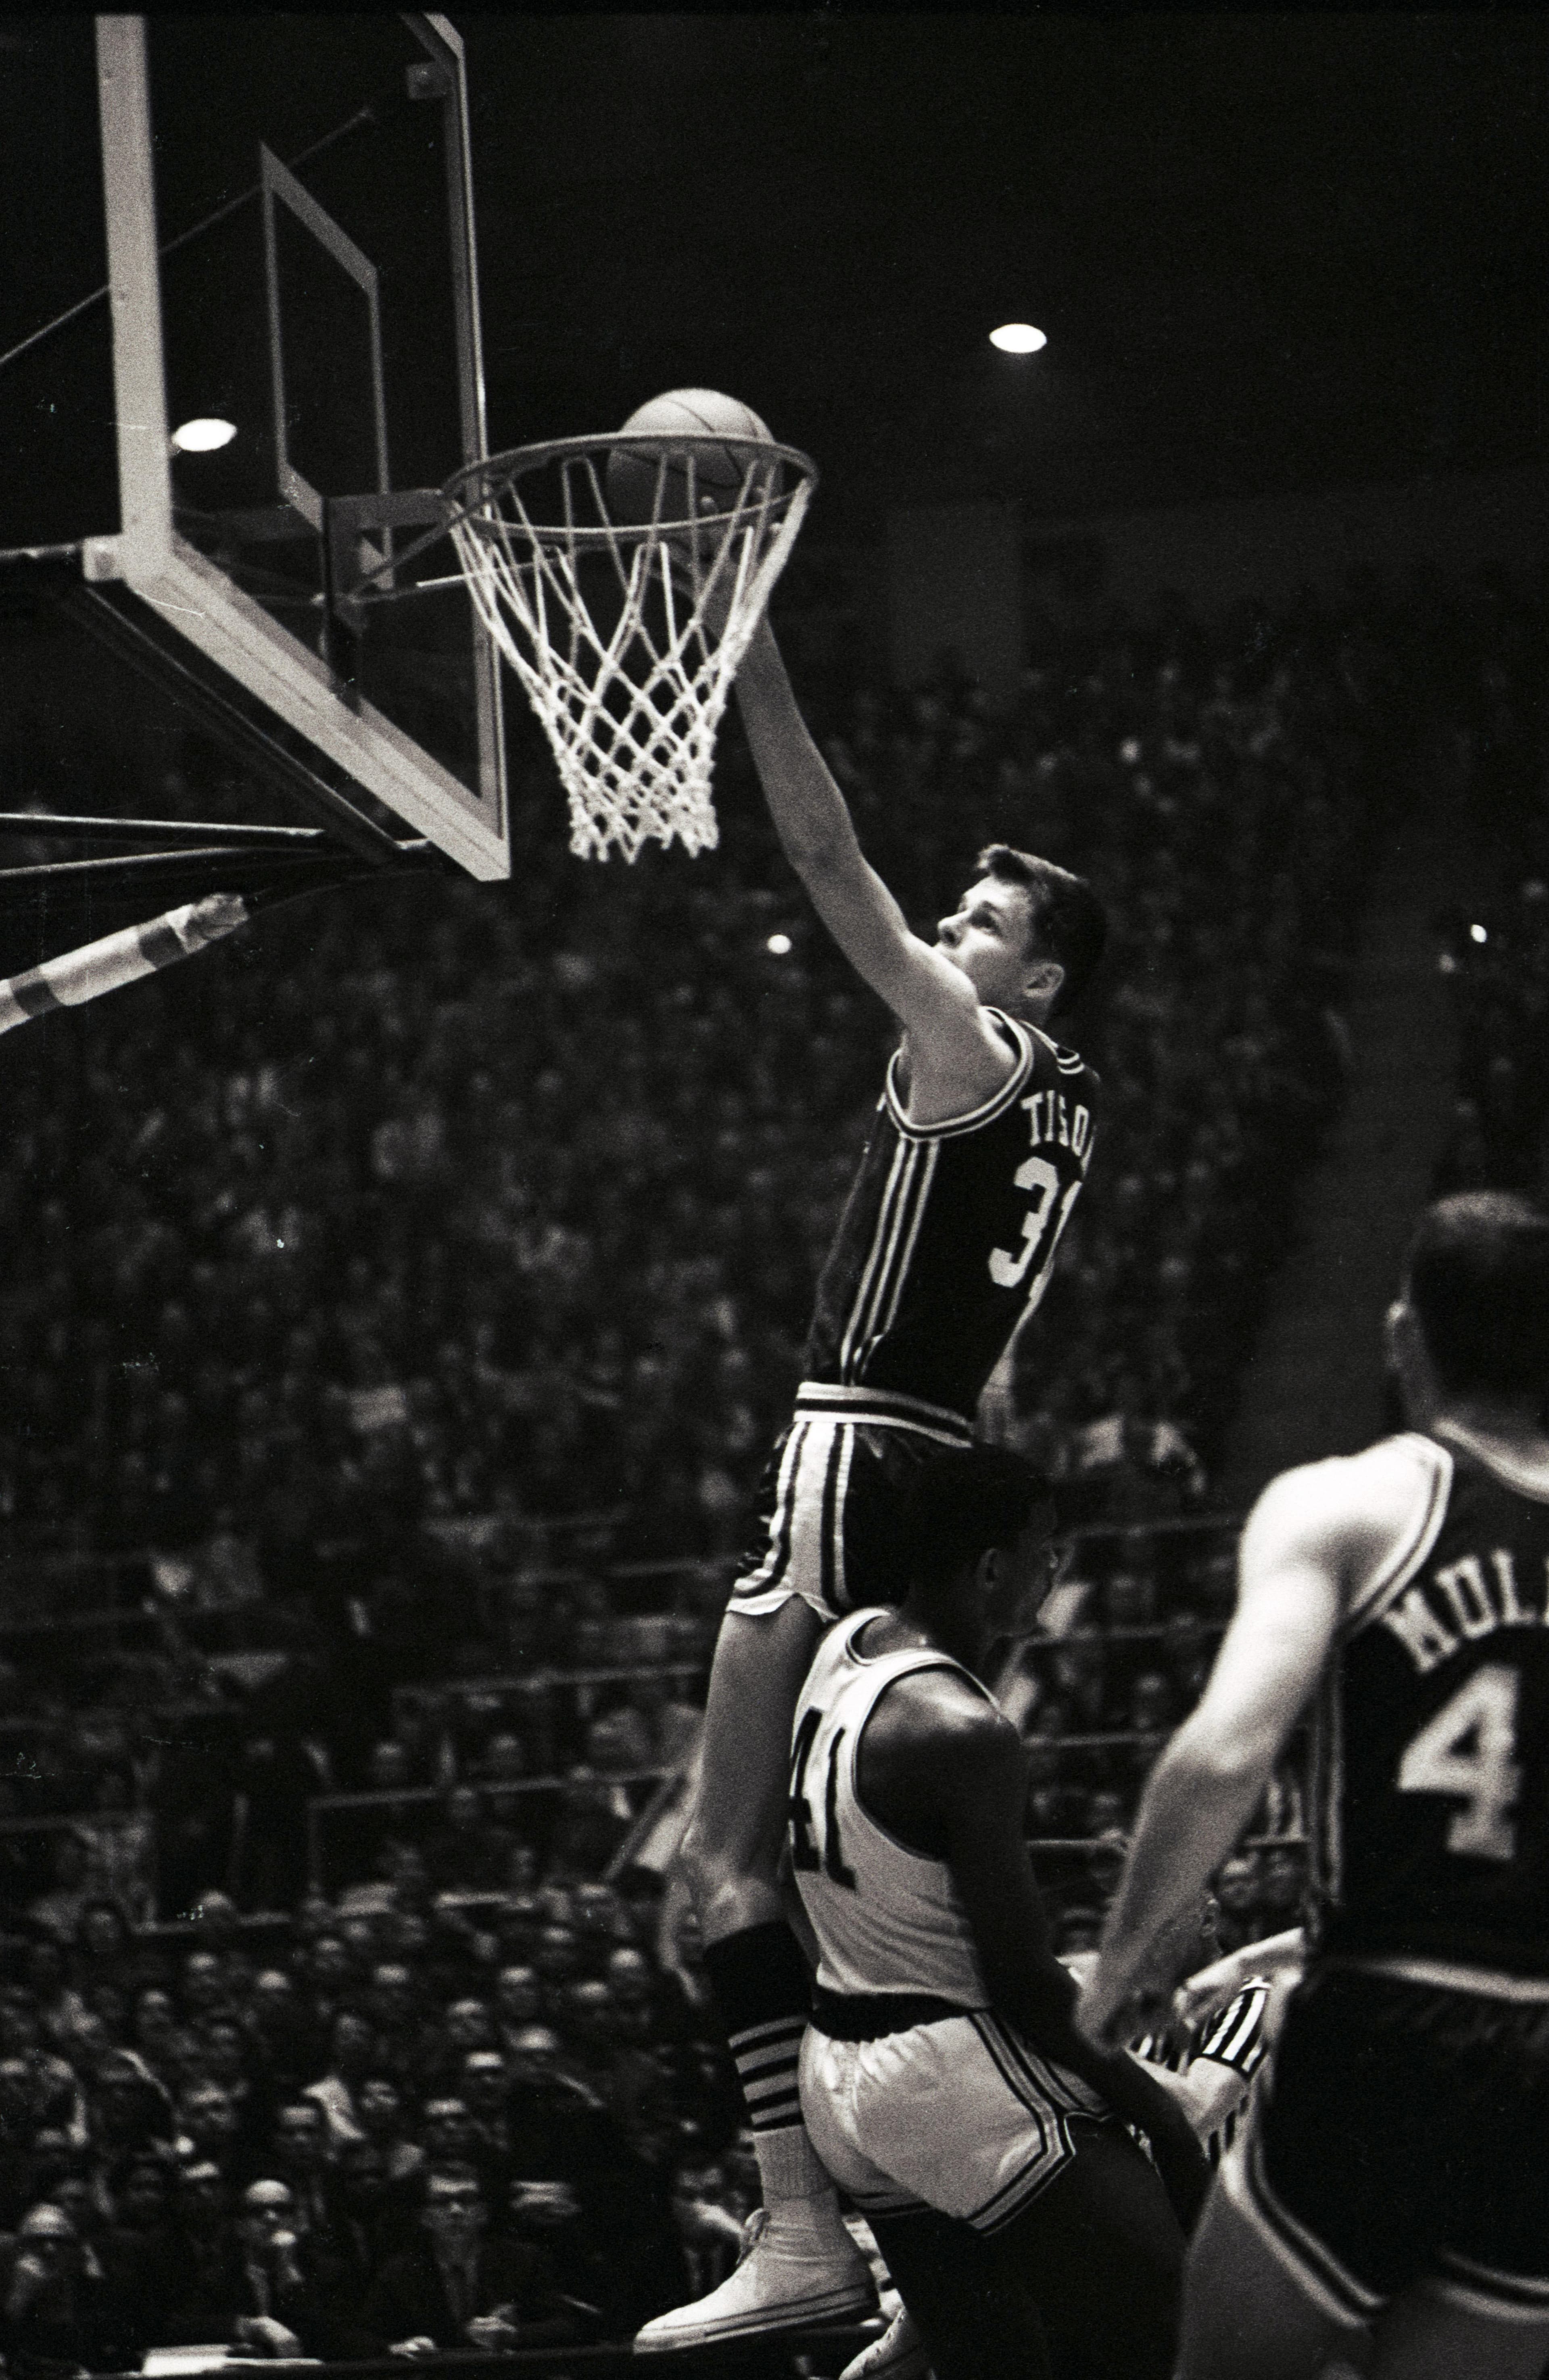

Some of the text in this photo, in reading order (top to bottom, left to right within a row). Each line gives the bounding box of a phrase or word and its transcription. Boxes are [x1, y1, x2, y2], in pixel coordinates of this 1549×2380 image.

[1020, 1089, 1096, 1178] TISO
[987, 1156, 1083, 1300] 3
[1382, 1547, 1549, 1674] MUL
[1397, 1662, 1521, 1860] 4
